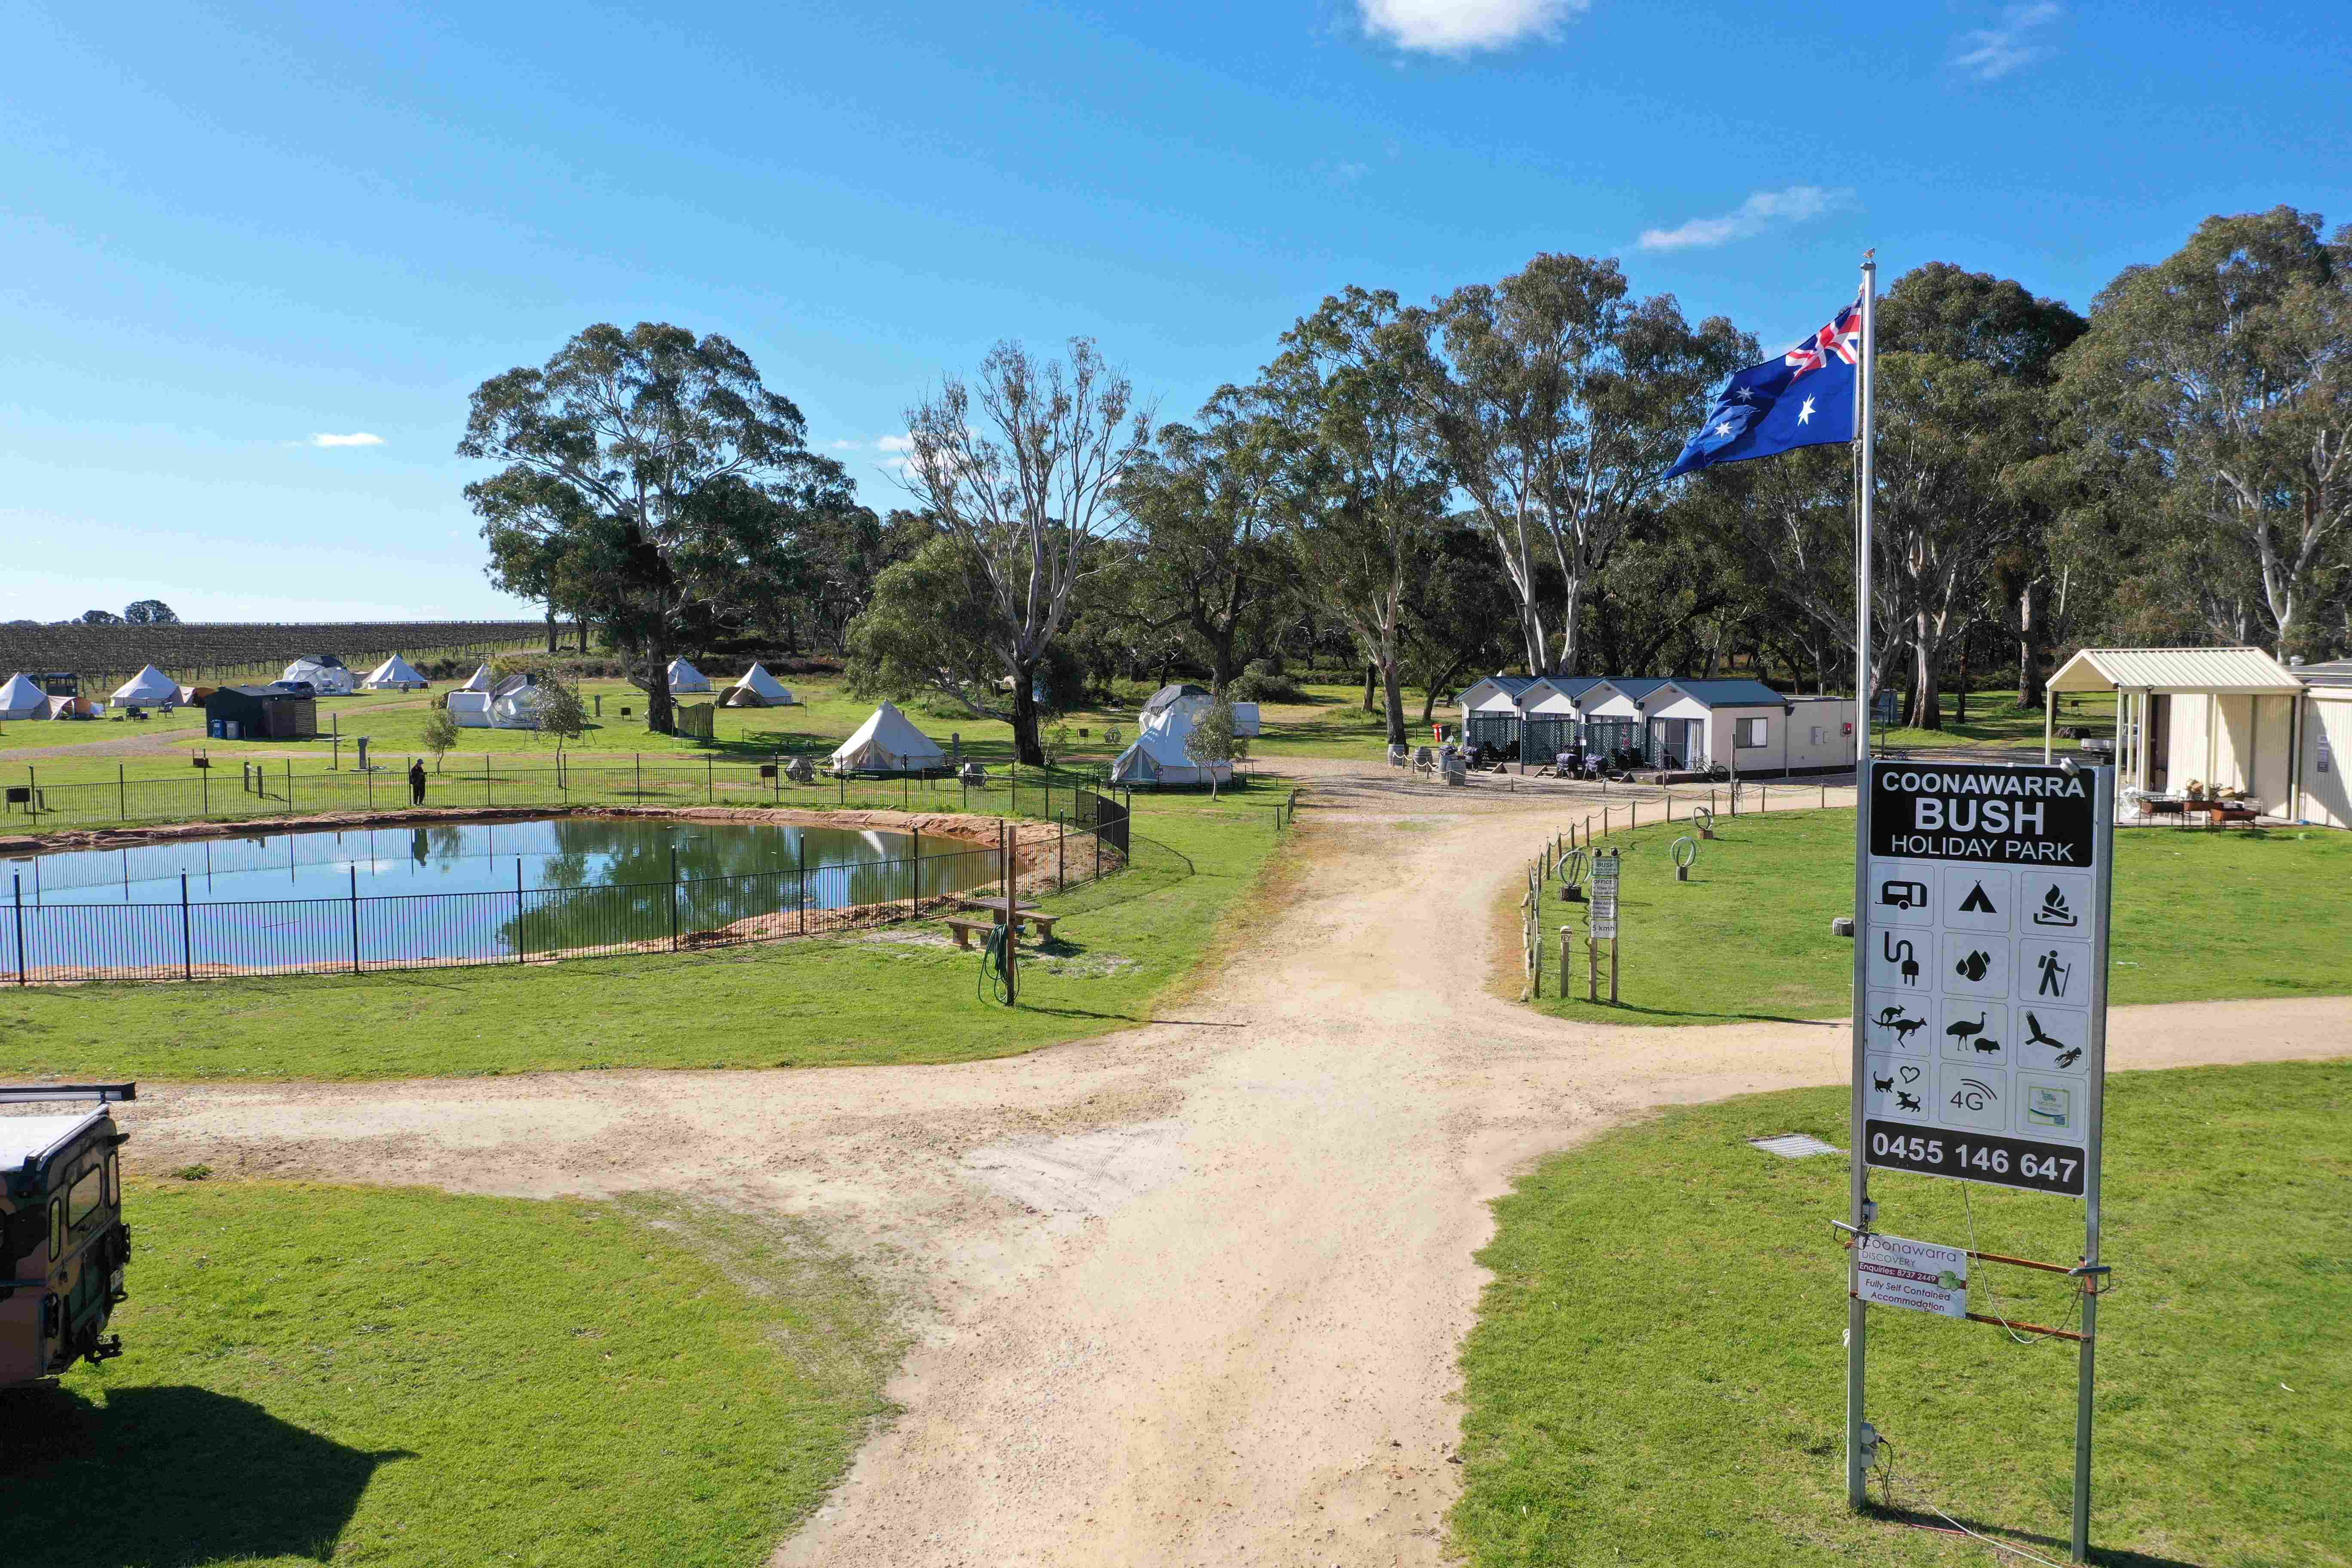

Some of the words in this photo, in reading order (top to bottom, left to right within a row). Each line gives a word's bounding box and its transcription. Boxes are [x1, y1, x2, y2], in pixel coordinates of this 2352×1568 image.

[1882, 772, 2086, 798] COONAWARRA
[1915, 797, 2044, 835] BUSH
[1892, 834, 1998, 858] HOLIDAY
[2006, 840, 2074, 862] PARK
[1950, 1091, 1983, 1111] 4G
[1873, 1133, 1943, 1163] 0455
[1955, 1144, 2009, 1173] 146
[2020, 1153, 2078, 1182] 647
[1862, 1251, 1916, 1267] DISCOVERY
[1859, 1263, 1895, 1275] Enquiries:
[1897, 1270, 1915, 1278] 8737
[1917, 1273, 1936, 1282] 2449
[1865, 1278, 1884, 1290] Fully
[1887, 1282, 1902, 1291] Self
[1904, 1286, 1951, 1301] Contained
[1871, 1291, 1945, 1311] Accommodation
